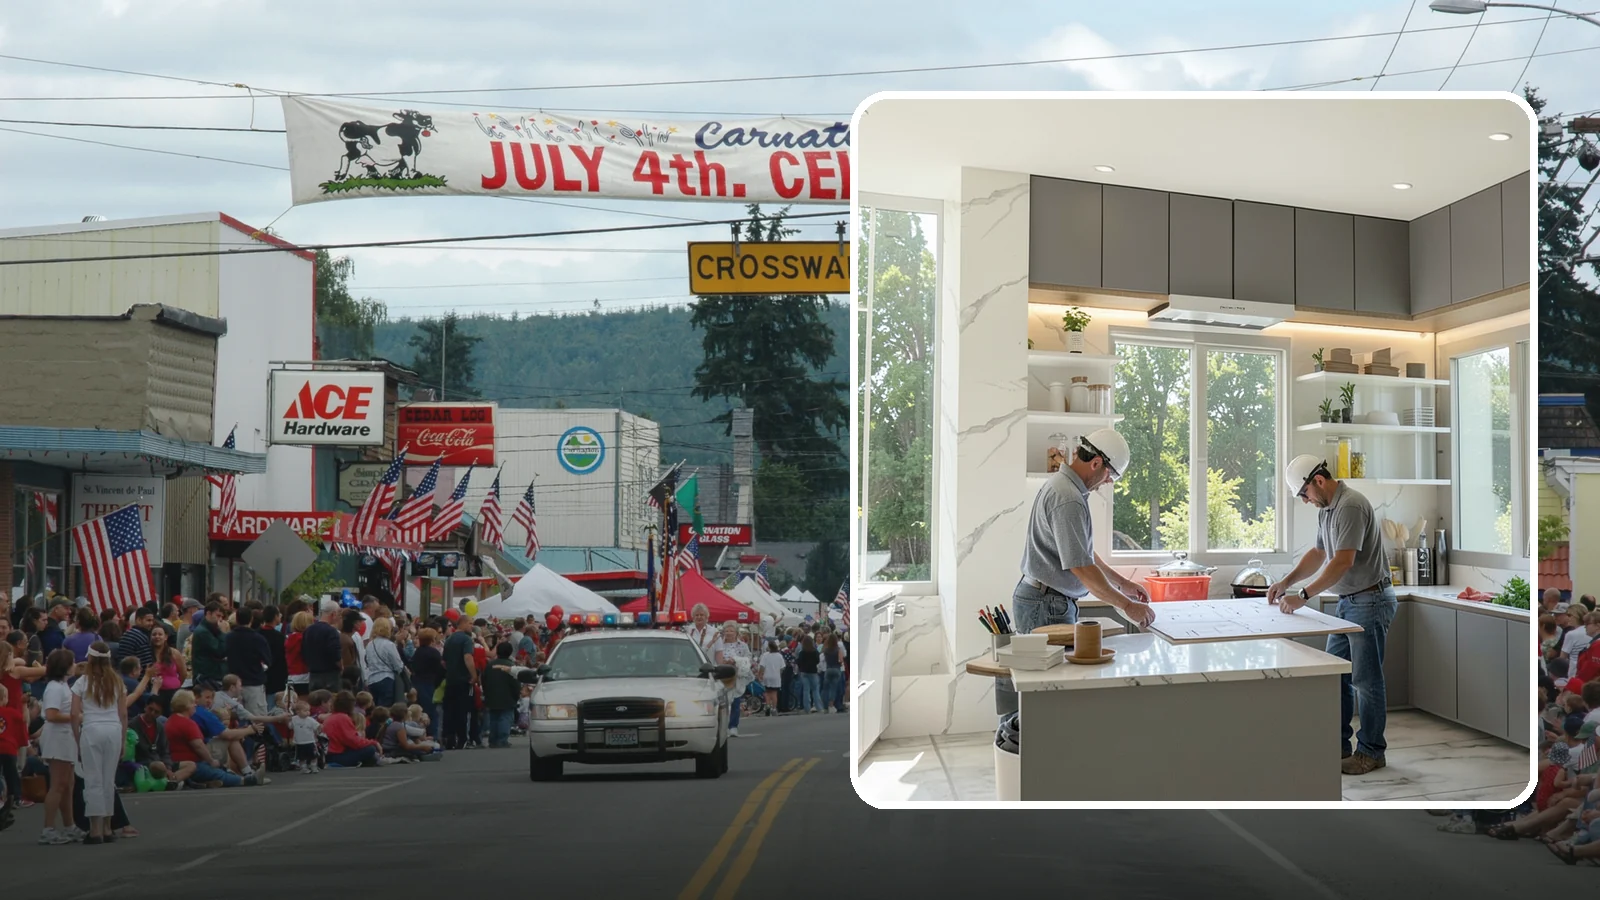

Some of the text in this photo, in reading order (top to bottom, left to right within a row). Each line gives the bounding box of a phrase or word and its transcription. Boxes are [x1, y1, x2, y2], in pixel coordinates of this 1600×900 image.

[695, 121, 850, 150] Carnat
[481, 140, 605, 192] JULY
[632, 150, 747, 199] 4th.
[697, 254, 850, 280] CROSSWA
[283, 380, 373, 420] ACE
[405, 409, 485, 422] CEDAR LOG
[283, 421, 370, 436] Hardware
[96, 486, 124, 494] Vincent
[138, 486, 155, 495] Paul
[212, 516, 331, 535] HARDARE
[688, 526, 741, 535] CRNATION
[699, 535, 730, 543] GLASS
